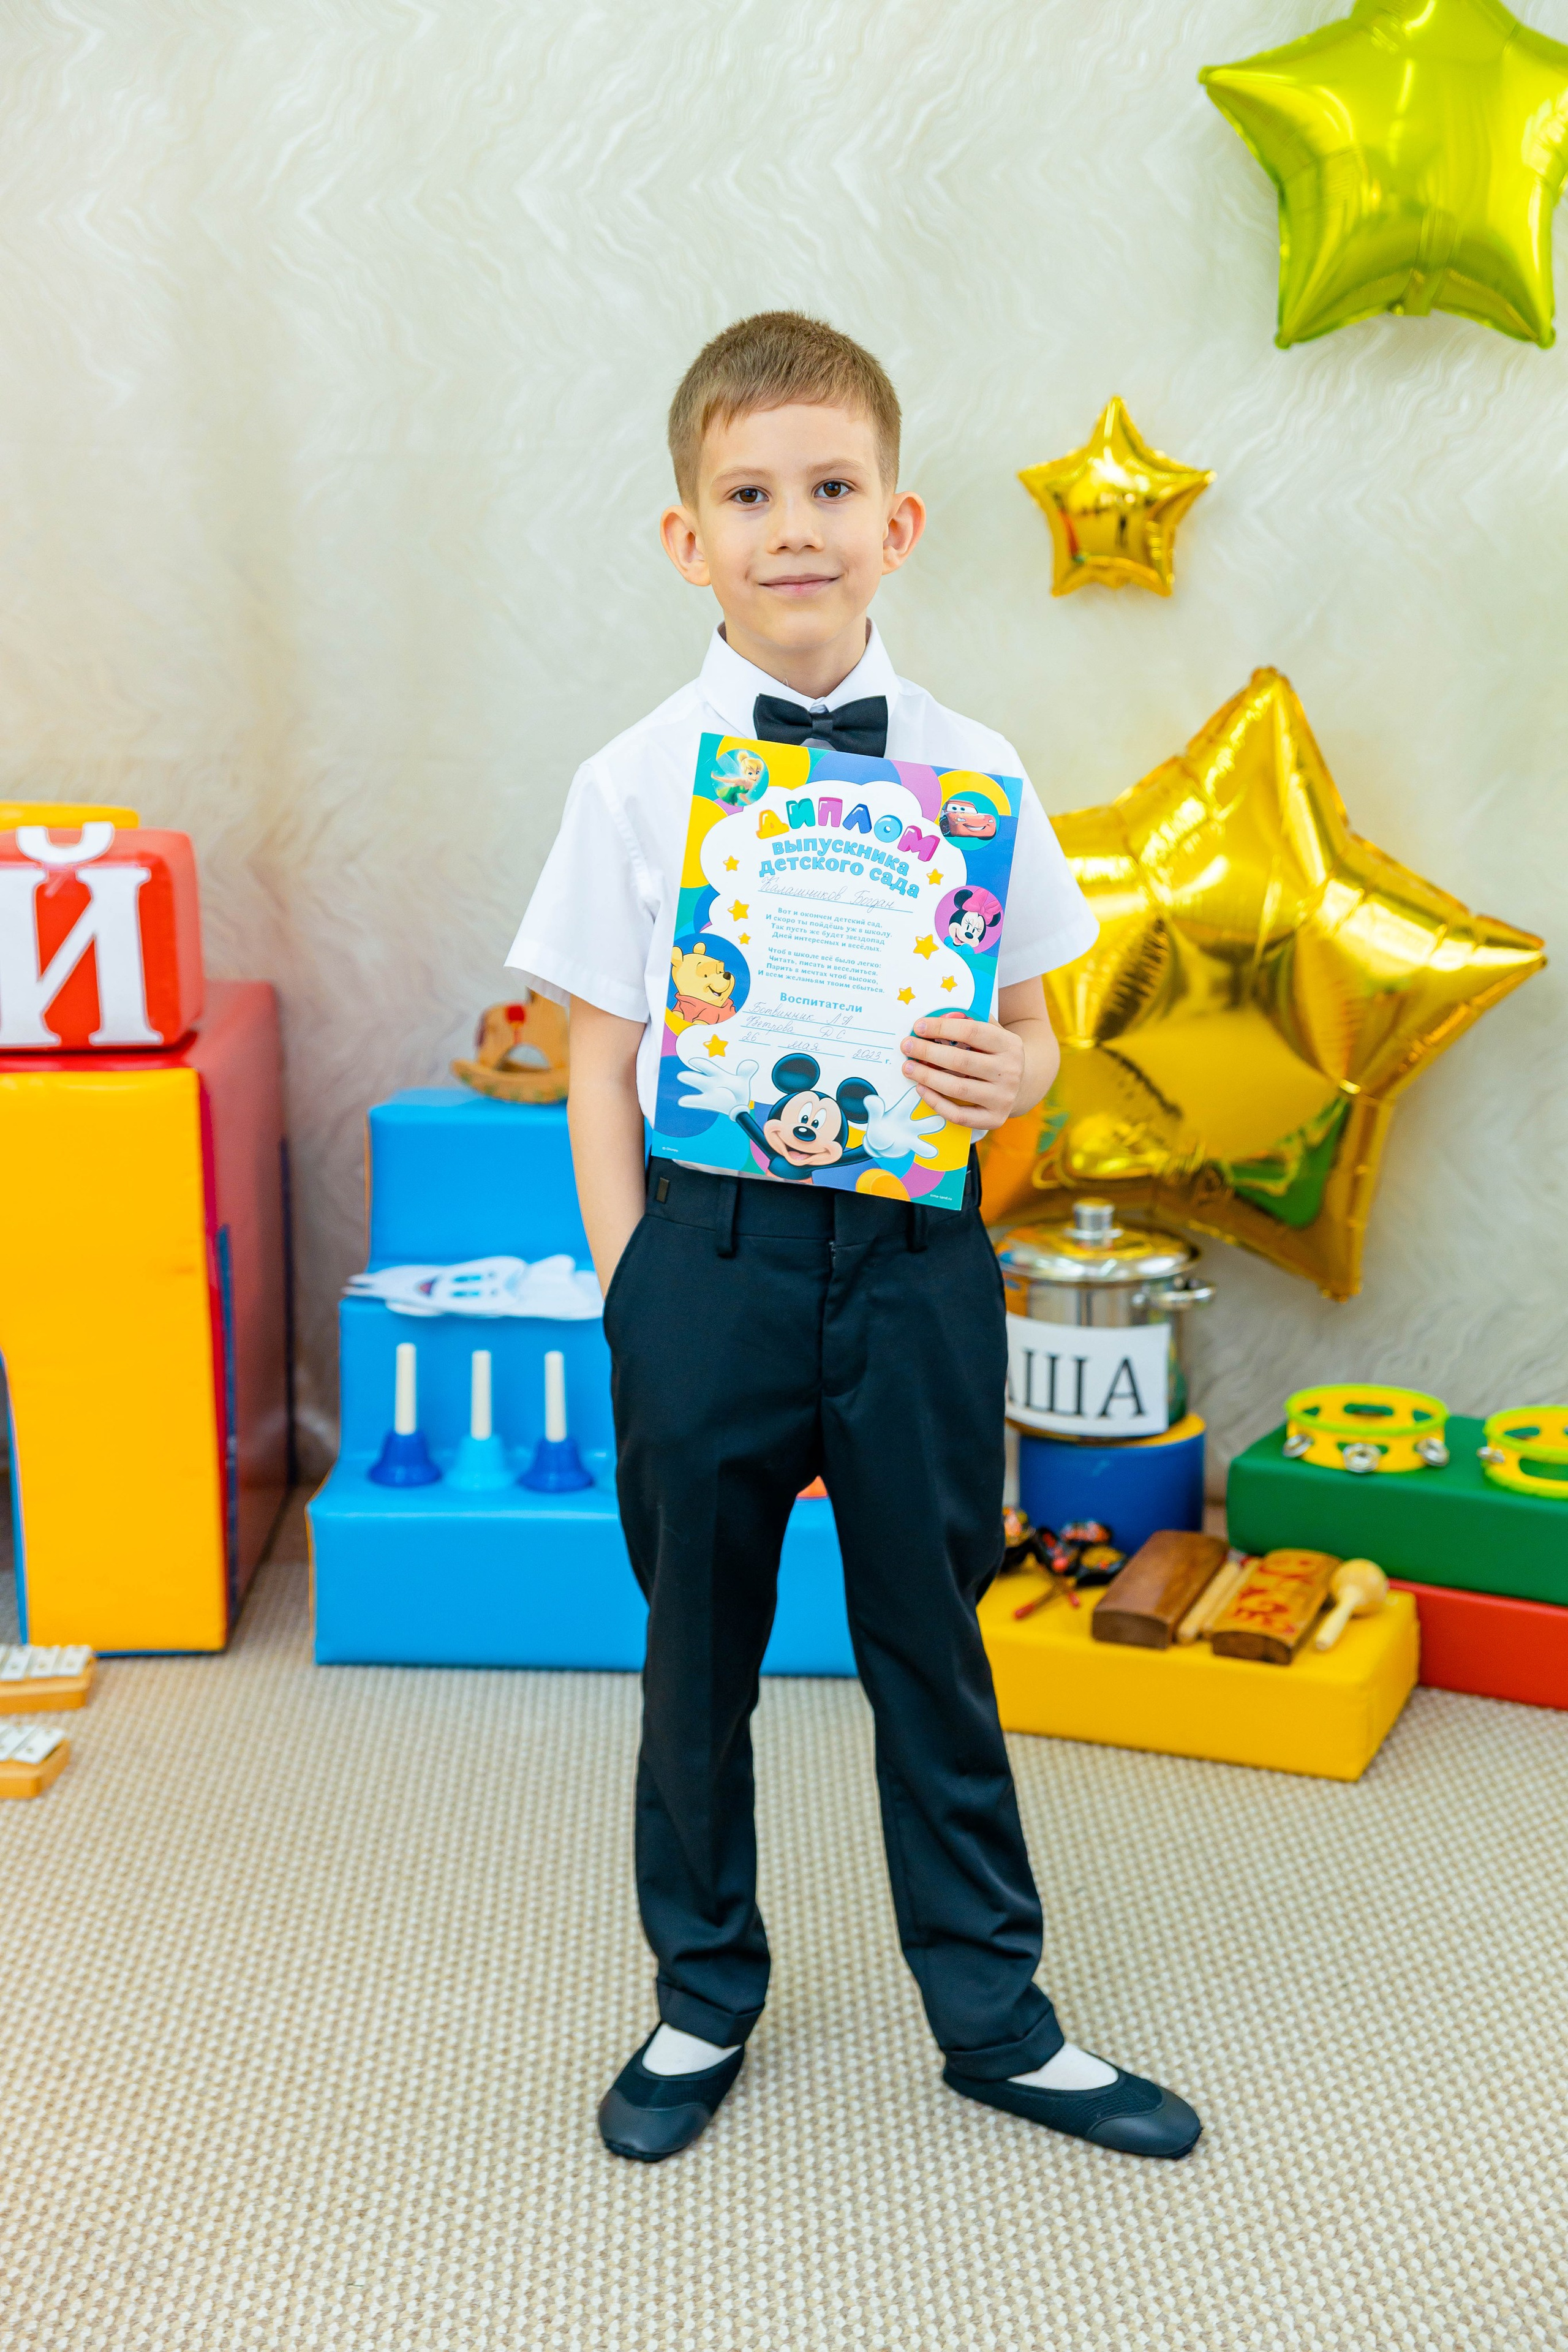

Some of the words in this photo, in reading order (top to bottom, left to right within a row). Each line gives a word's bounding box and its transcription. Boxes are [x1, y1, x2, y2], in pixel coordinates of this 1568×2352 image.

[756, 797, 940, 862] ДИПЛОМ
[772, 838, 910, 876] выпускника
[759, 856, 864, 877] детского
[869, 868, 919, 899] сада
[850, 891, 895, 913] Богдан
[800, 912, 832, 921] окончен
[834, 916, 865, 925] детский
[0, 821, 164, 1047] Й
[810, 921, 844, 930] пойдёшь
[864, 929, 892, 938] школу.
[846, 935, 885, 945] звездопад
[772, 931, 793, 940] Дней
[794, 935, 839, 946] интересных
[848, 943, 882, 952] весёлых.
[766, 962, 793, 972] Парить
[848, 976, 878, 985] высоко,
[769, 955, 797, 965] Читать,
[834, 965, 878, 976] веселиться.
[785, 974, 825, 984] желаньям
[852, 984, 885, 993] сбыться.
[748, 1001, 815, 1021] Ботвинник
[780, 992, 863, 1012] Воспитатели
[746, 1015, 796, 1035] Ветрова
[742, 1031, 760, 1042] 26
[788, 1041, 821, 1051] мая
[853, 1049, 882, 1060] 2023
